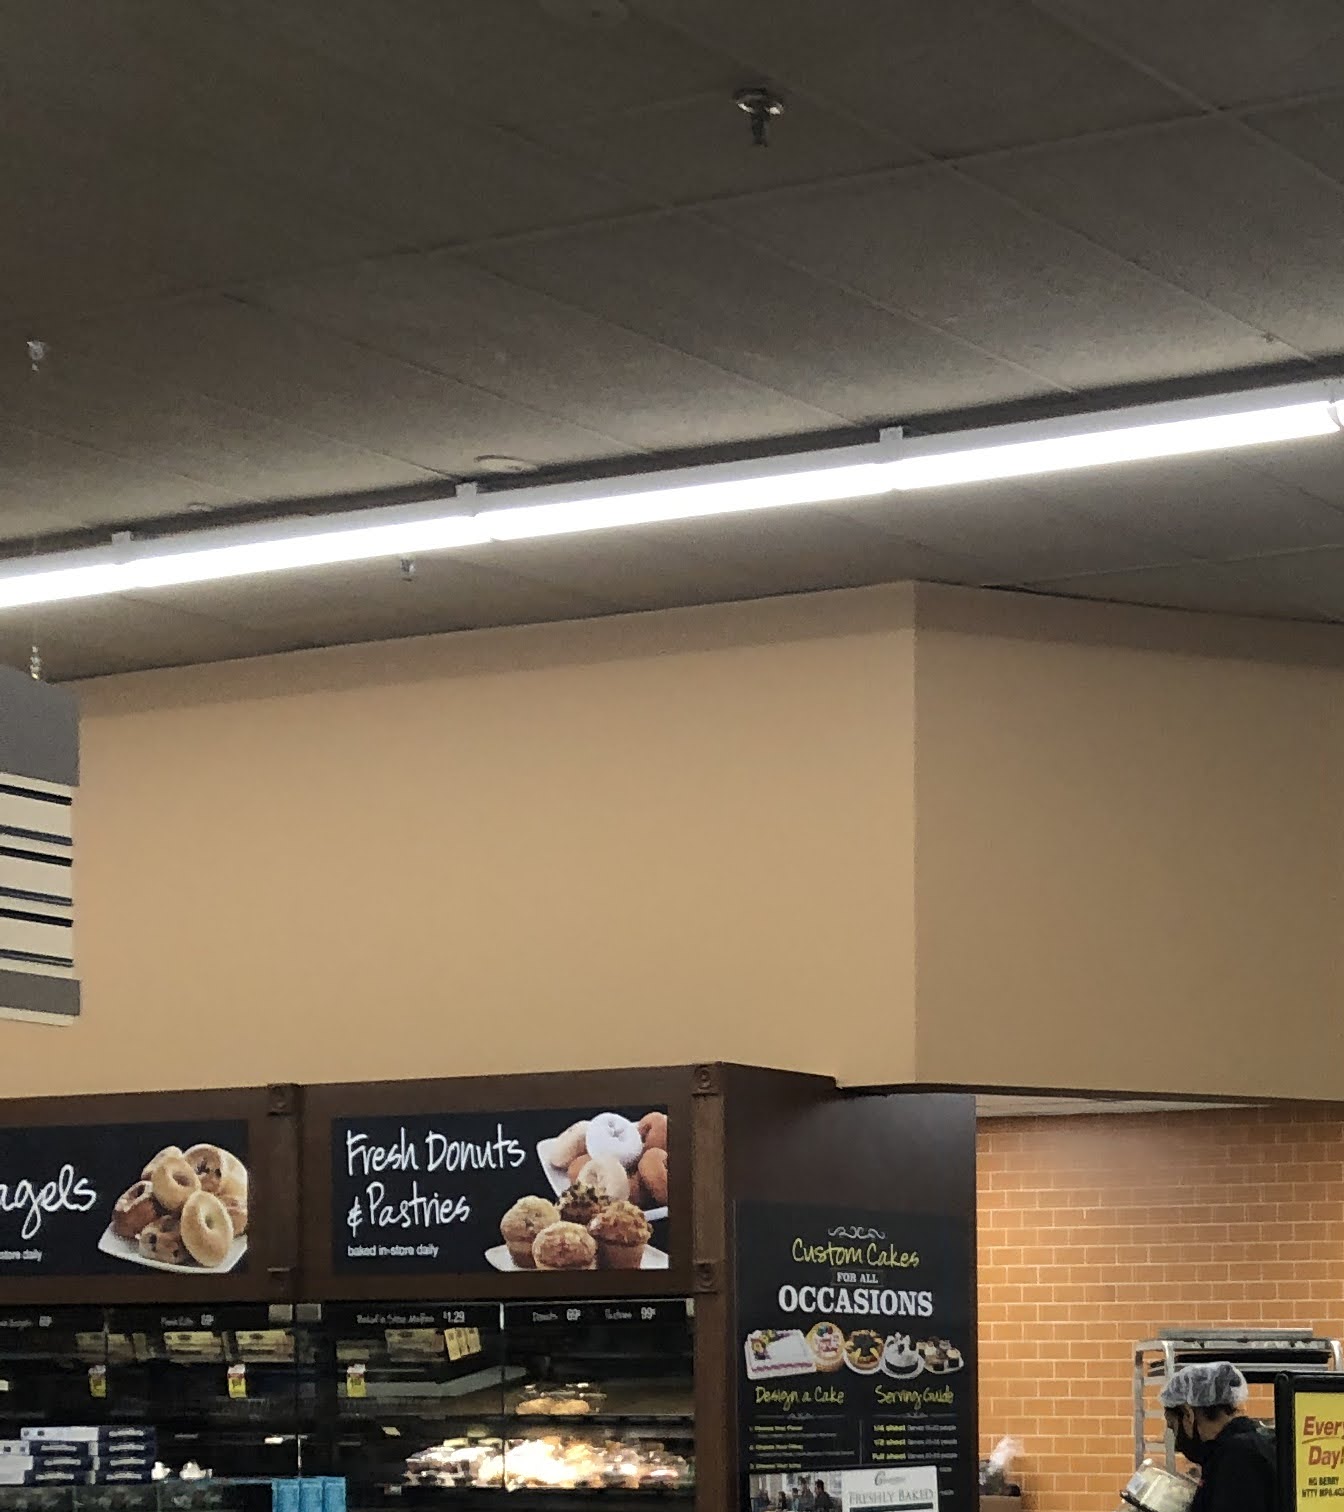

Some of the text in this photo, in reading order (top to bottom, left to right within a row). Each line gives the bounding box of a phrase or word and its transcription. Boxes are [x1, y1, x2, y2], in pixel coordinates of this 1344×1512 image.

[346, 1123, 527, 1177] Fresh Donuts
[366, 1181, 471, 1228] Pastries
[416, 1244, 440, 1259] daily
[792, 1237, 920, 1269] Custom Cakes
[836, 1271, 879, 1285] FOR ALL
[778, 1284, 934, 1318] OCCASIONS
[755, 1385, 799, 1412] Design
[814, 1385, 845, 1405] Cake
[922, 1384, 955, 1405] Guide
[1308, 1445, 1344, 1469] Day!
